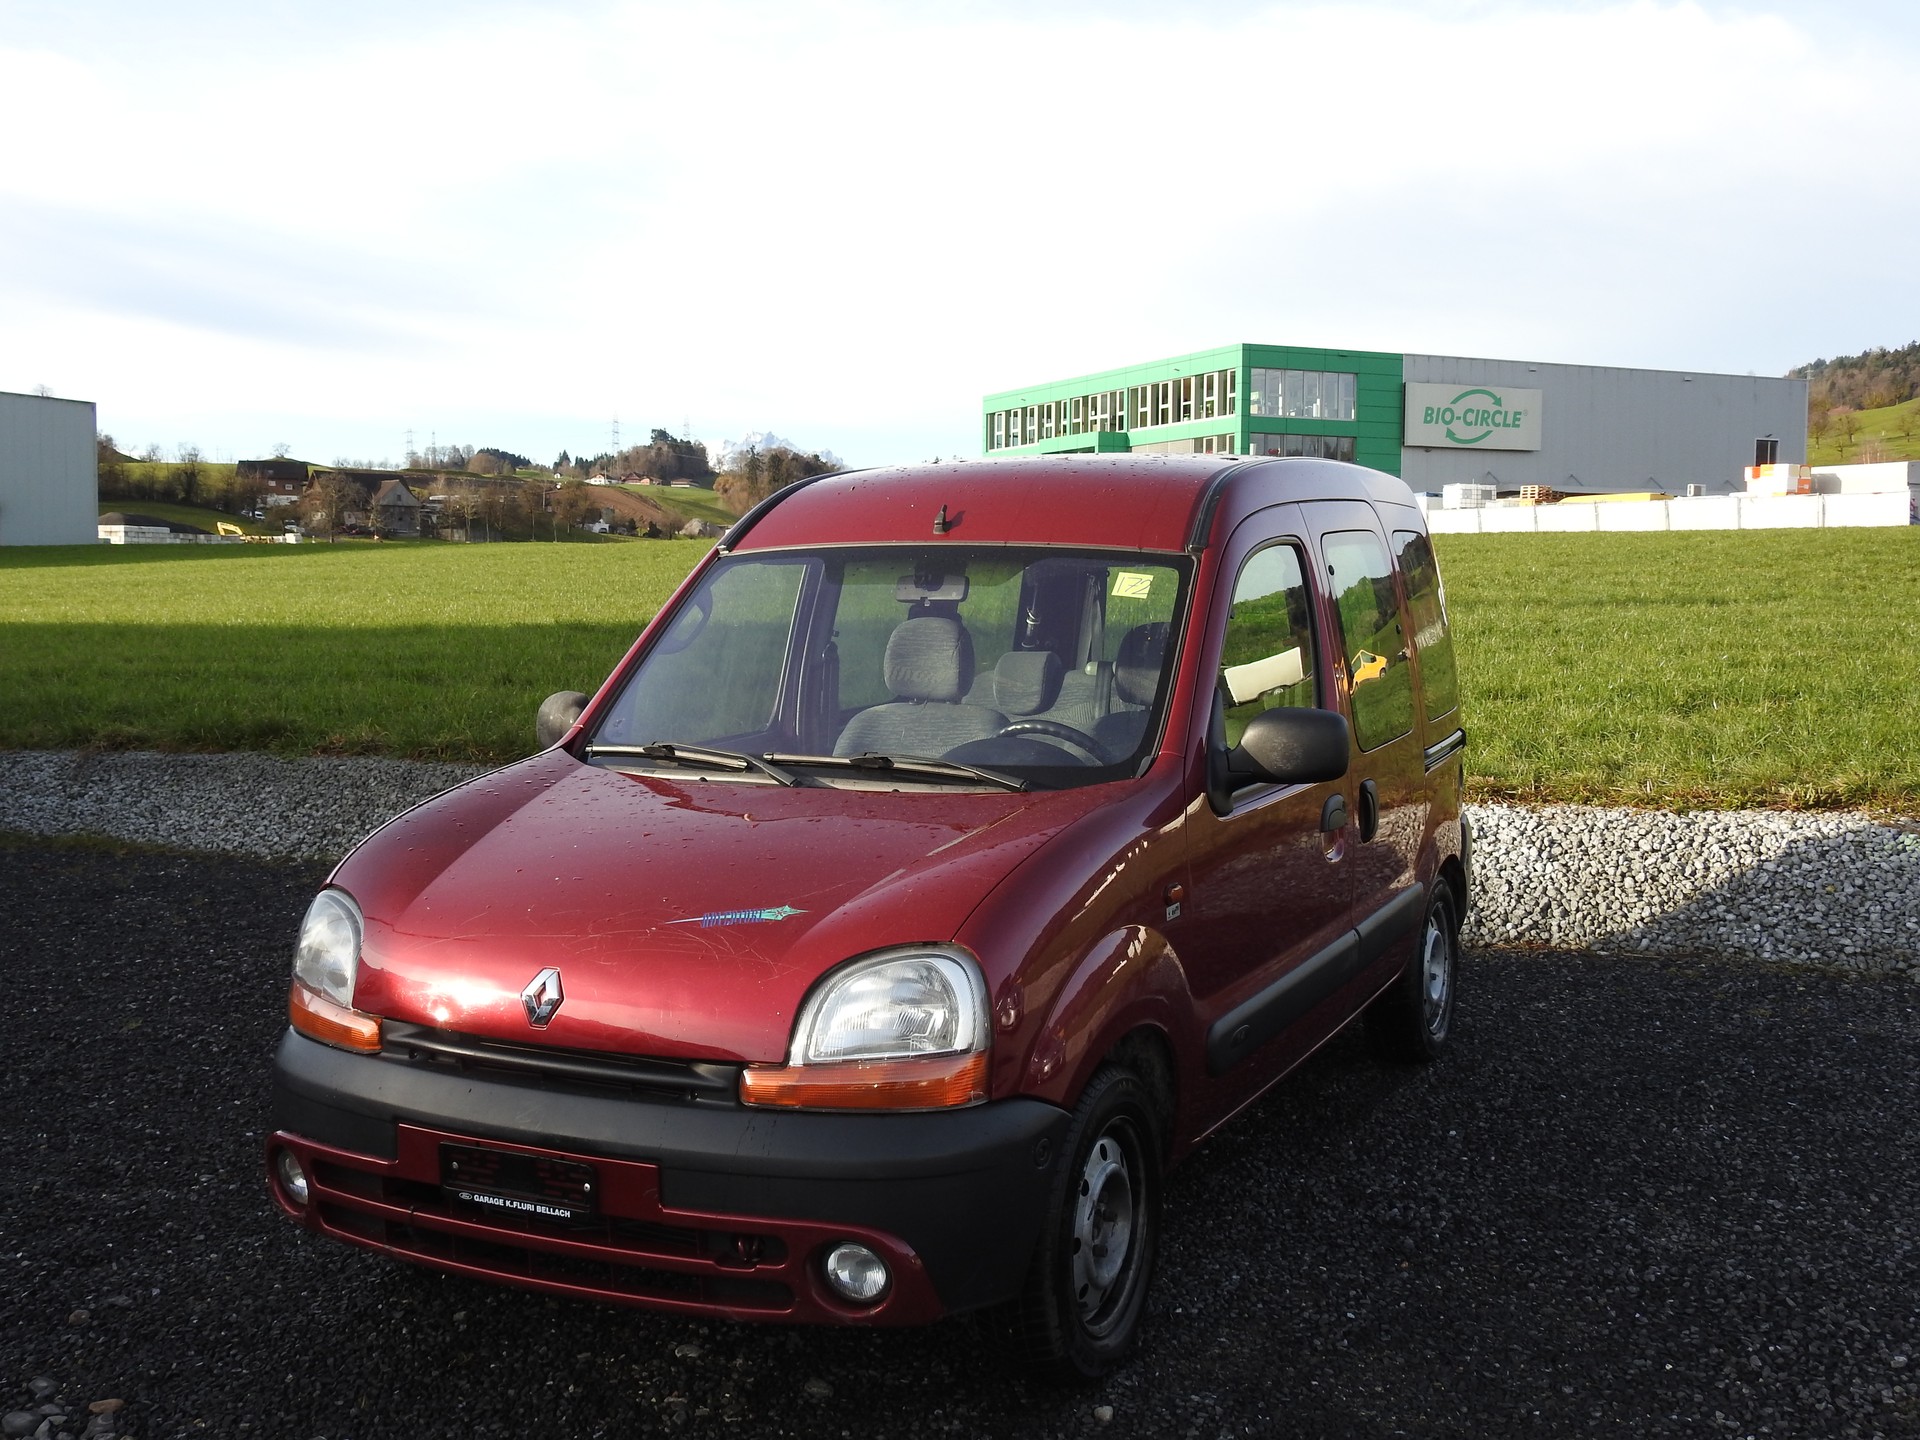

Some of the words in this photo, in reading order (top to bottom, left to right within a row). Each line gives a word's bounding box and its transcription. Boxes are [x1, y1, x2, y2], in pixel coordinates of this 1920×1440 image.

[1423, 406, 1522, 428] BIO-CIRCLE
[1117, 577, 1152, 595] 172
[473, 1194, 504, 1206] GARAGE
[536, 1205, 571, 1218] BELLACH
